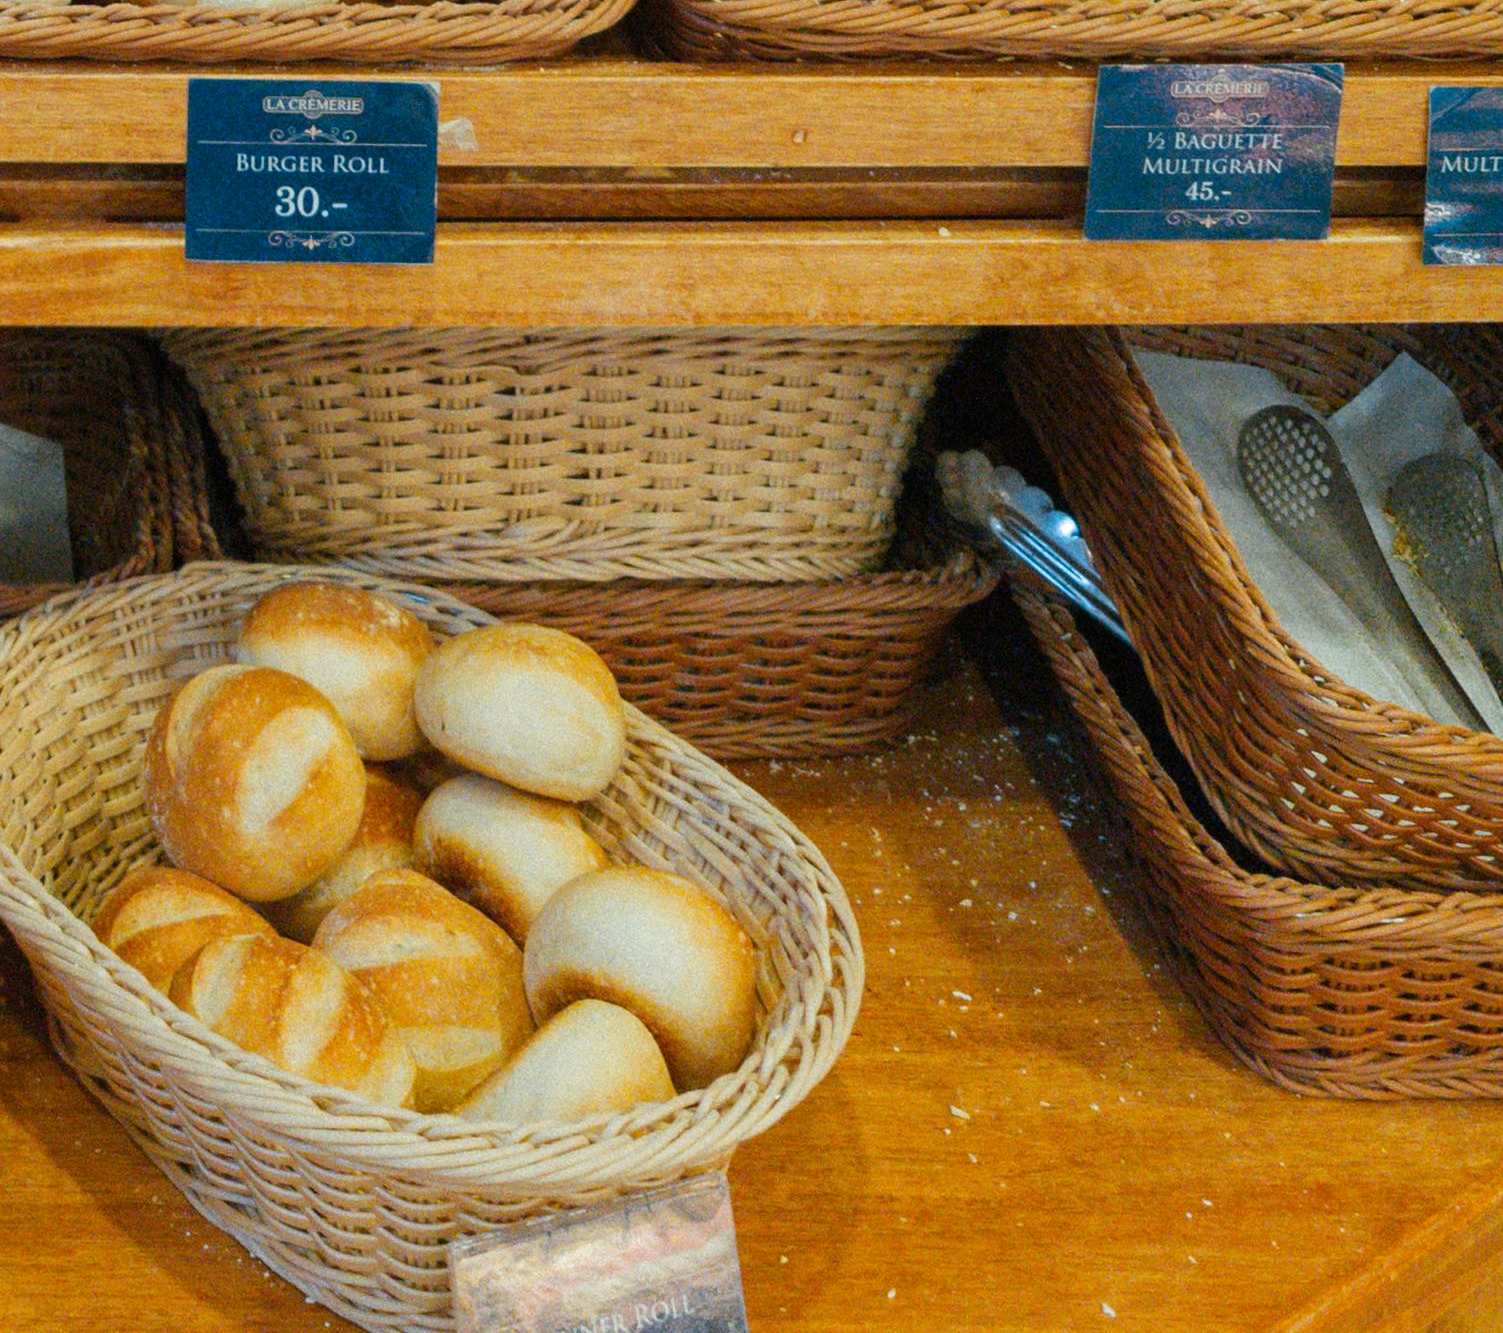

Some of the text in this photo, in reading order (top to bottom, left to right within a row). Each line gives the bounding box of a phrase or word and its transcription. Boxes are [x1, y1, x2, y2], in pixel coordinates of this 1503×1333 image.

[1174, 84, 1193, 95] LA
[267, 100, 286, 111] LA
[1174, 131, 1283, 152] BAGUETTE
[236, 152, 390, 174] BURGER ROLL
[1142, 157, 1284, 175] MULTIGRAIN
[274, 186, 349, 218] 30.-
[1184, 181, 1232, 202] 45.-
[634, 1293, 696, 1329] ROLL
